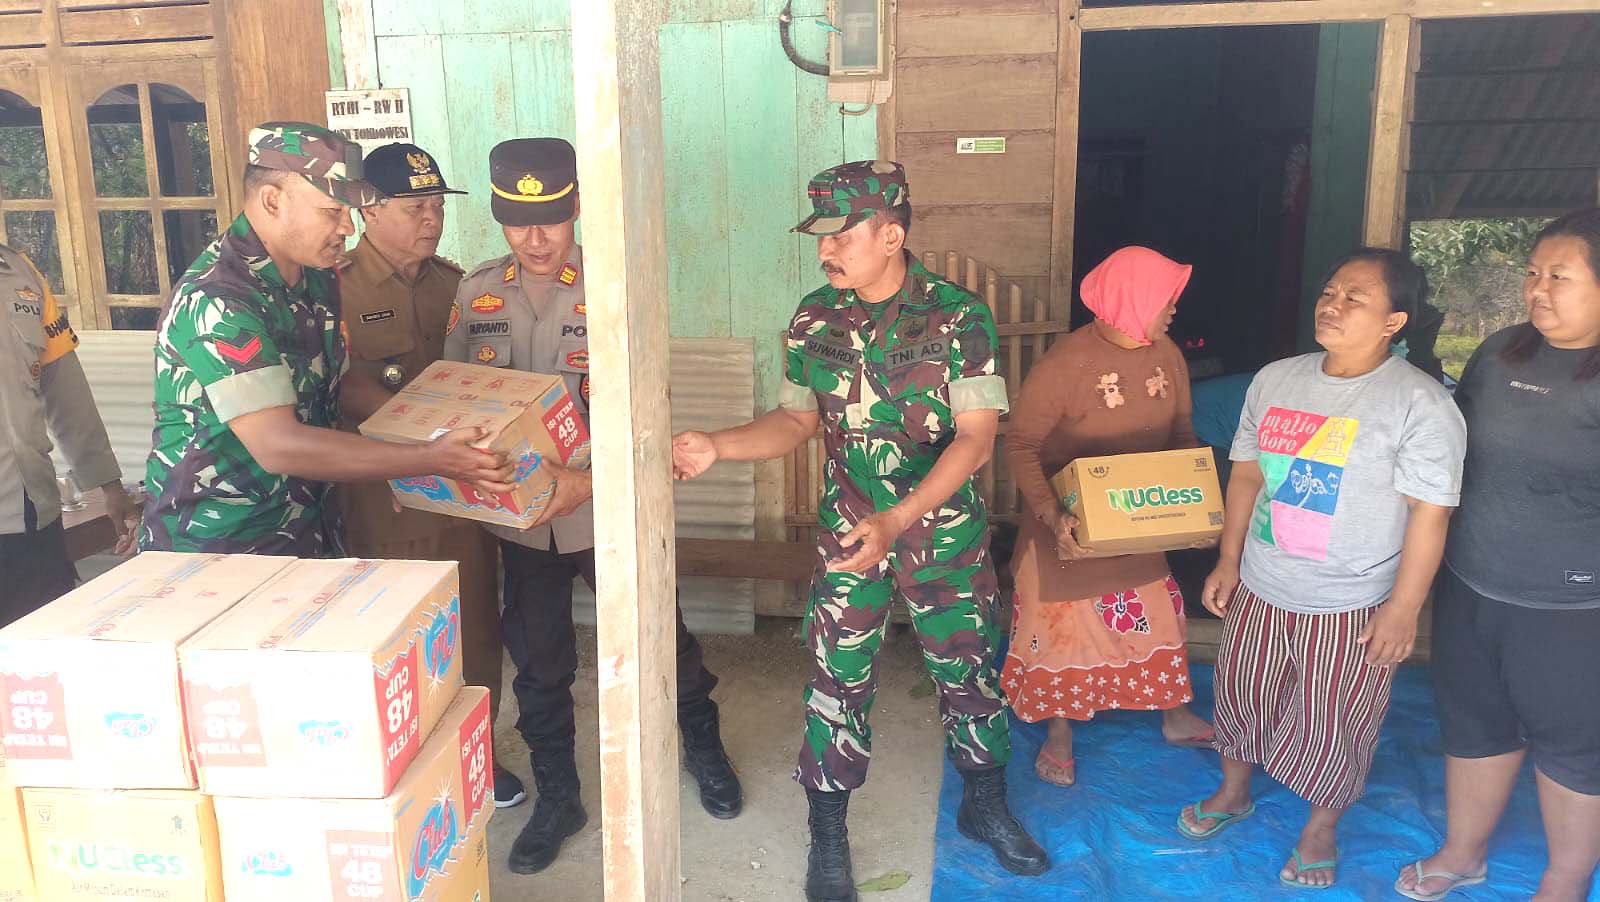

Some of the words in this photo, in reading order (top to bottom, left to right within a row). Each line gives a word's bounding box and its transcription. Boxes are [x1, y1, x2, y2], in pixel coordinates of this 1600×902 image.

[807, 340, 855, 365] SUWARDI
[890, 349, 915, 364] TNI
[920, 343, 943, 358] AD
[546, 418, 557, 431] ISI
[554, 401, 573, 421] TETAP
[558, 416, 575, 439] 48
[564, 429, 579, 448] CUP
[385, 665, 409, 700] CUP
[11, 706, 54, 730] 48
[387, 688, 413, 734] 48
[462, 739, 472, 760] ISI
[468, 742, 485, 784] 48
[472, 771, 486, 802] CUP
[341, 860, 383, 883] 48
